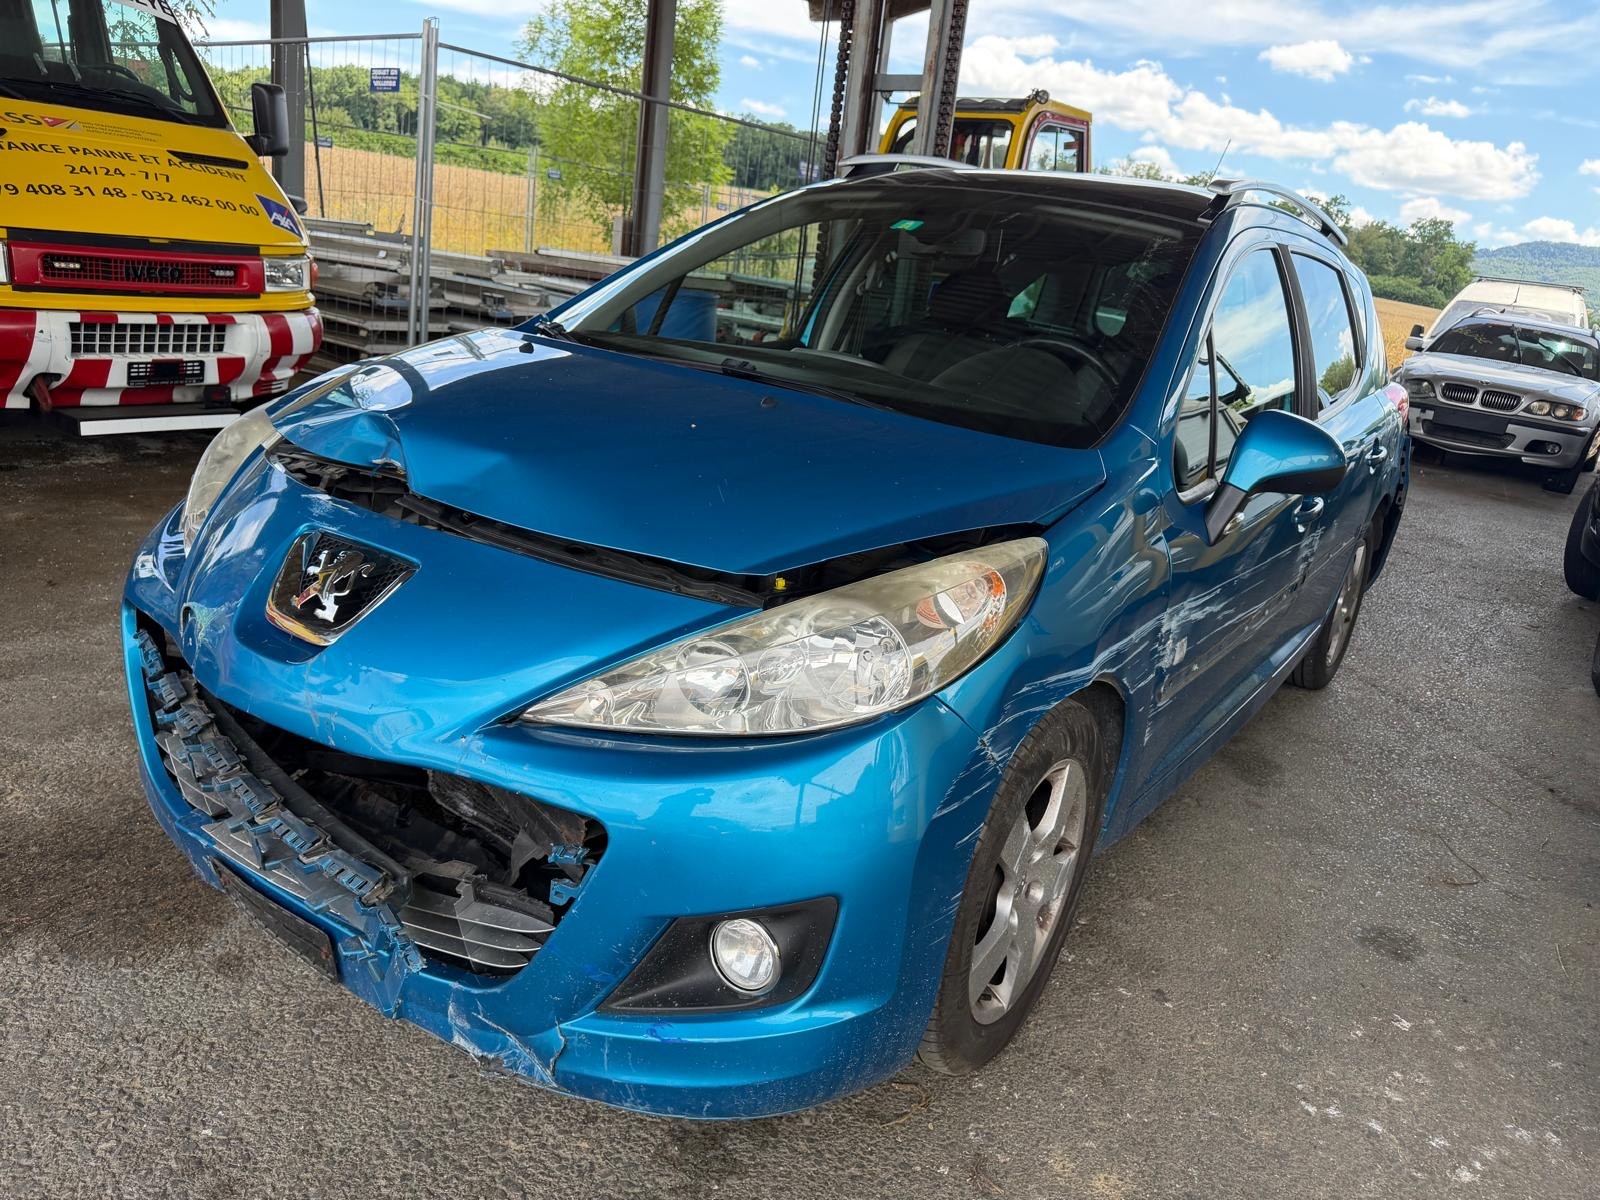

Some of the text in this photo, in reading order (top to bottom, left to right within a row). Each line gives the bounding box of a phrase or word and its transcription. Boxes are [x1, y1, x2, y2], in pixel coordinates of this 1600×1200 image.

[64, 164, 126, 177] 24/24
[138, 170, 170, 183] 7/7
[68, 145, 138, 162] PANNE
[139, 153, 161, 166] ET
[167, 158, 248, 183] ACCIDENT
[0, 183, 20, 196] 9
[26, 183, 67, 196] 408
[69, 185, 96, 197] 31
[102, 187, 128, 199] 48
[141, 189, 178, 204] 032
[181, 194, 214, 209] 462
[216, 199, 238, 213] 00
[240, 204, 260, 217] 00
[125, 265, 183, 281] IVECO
